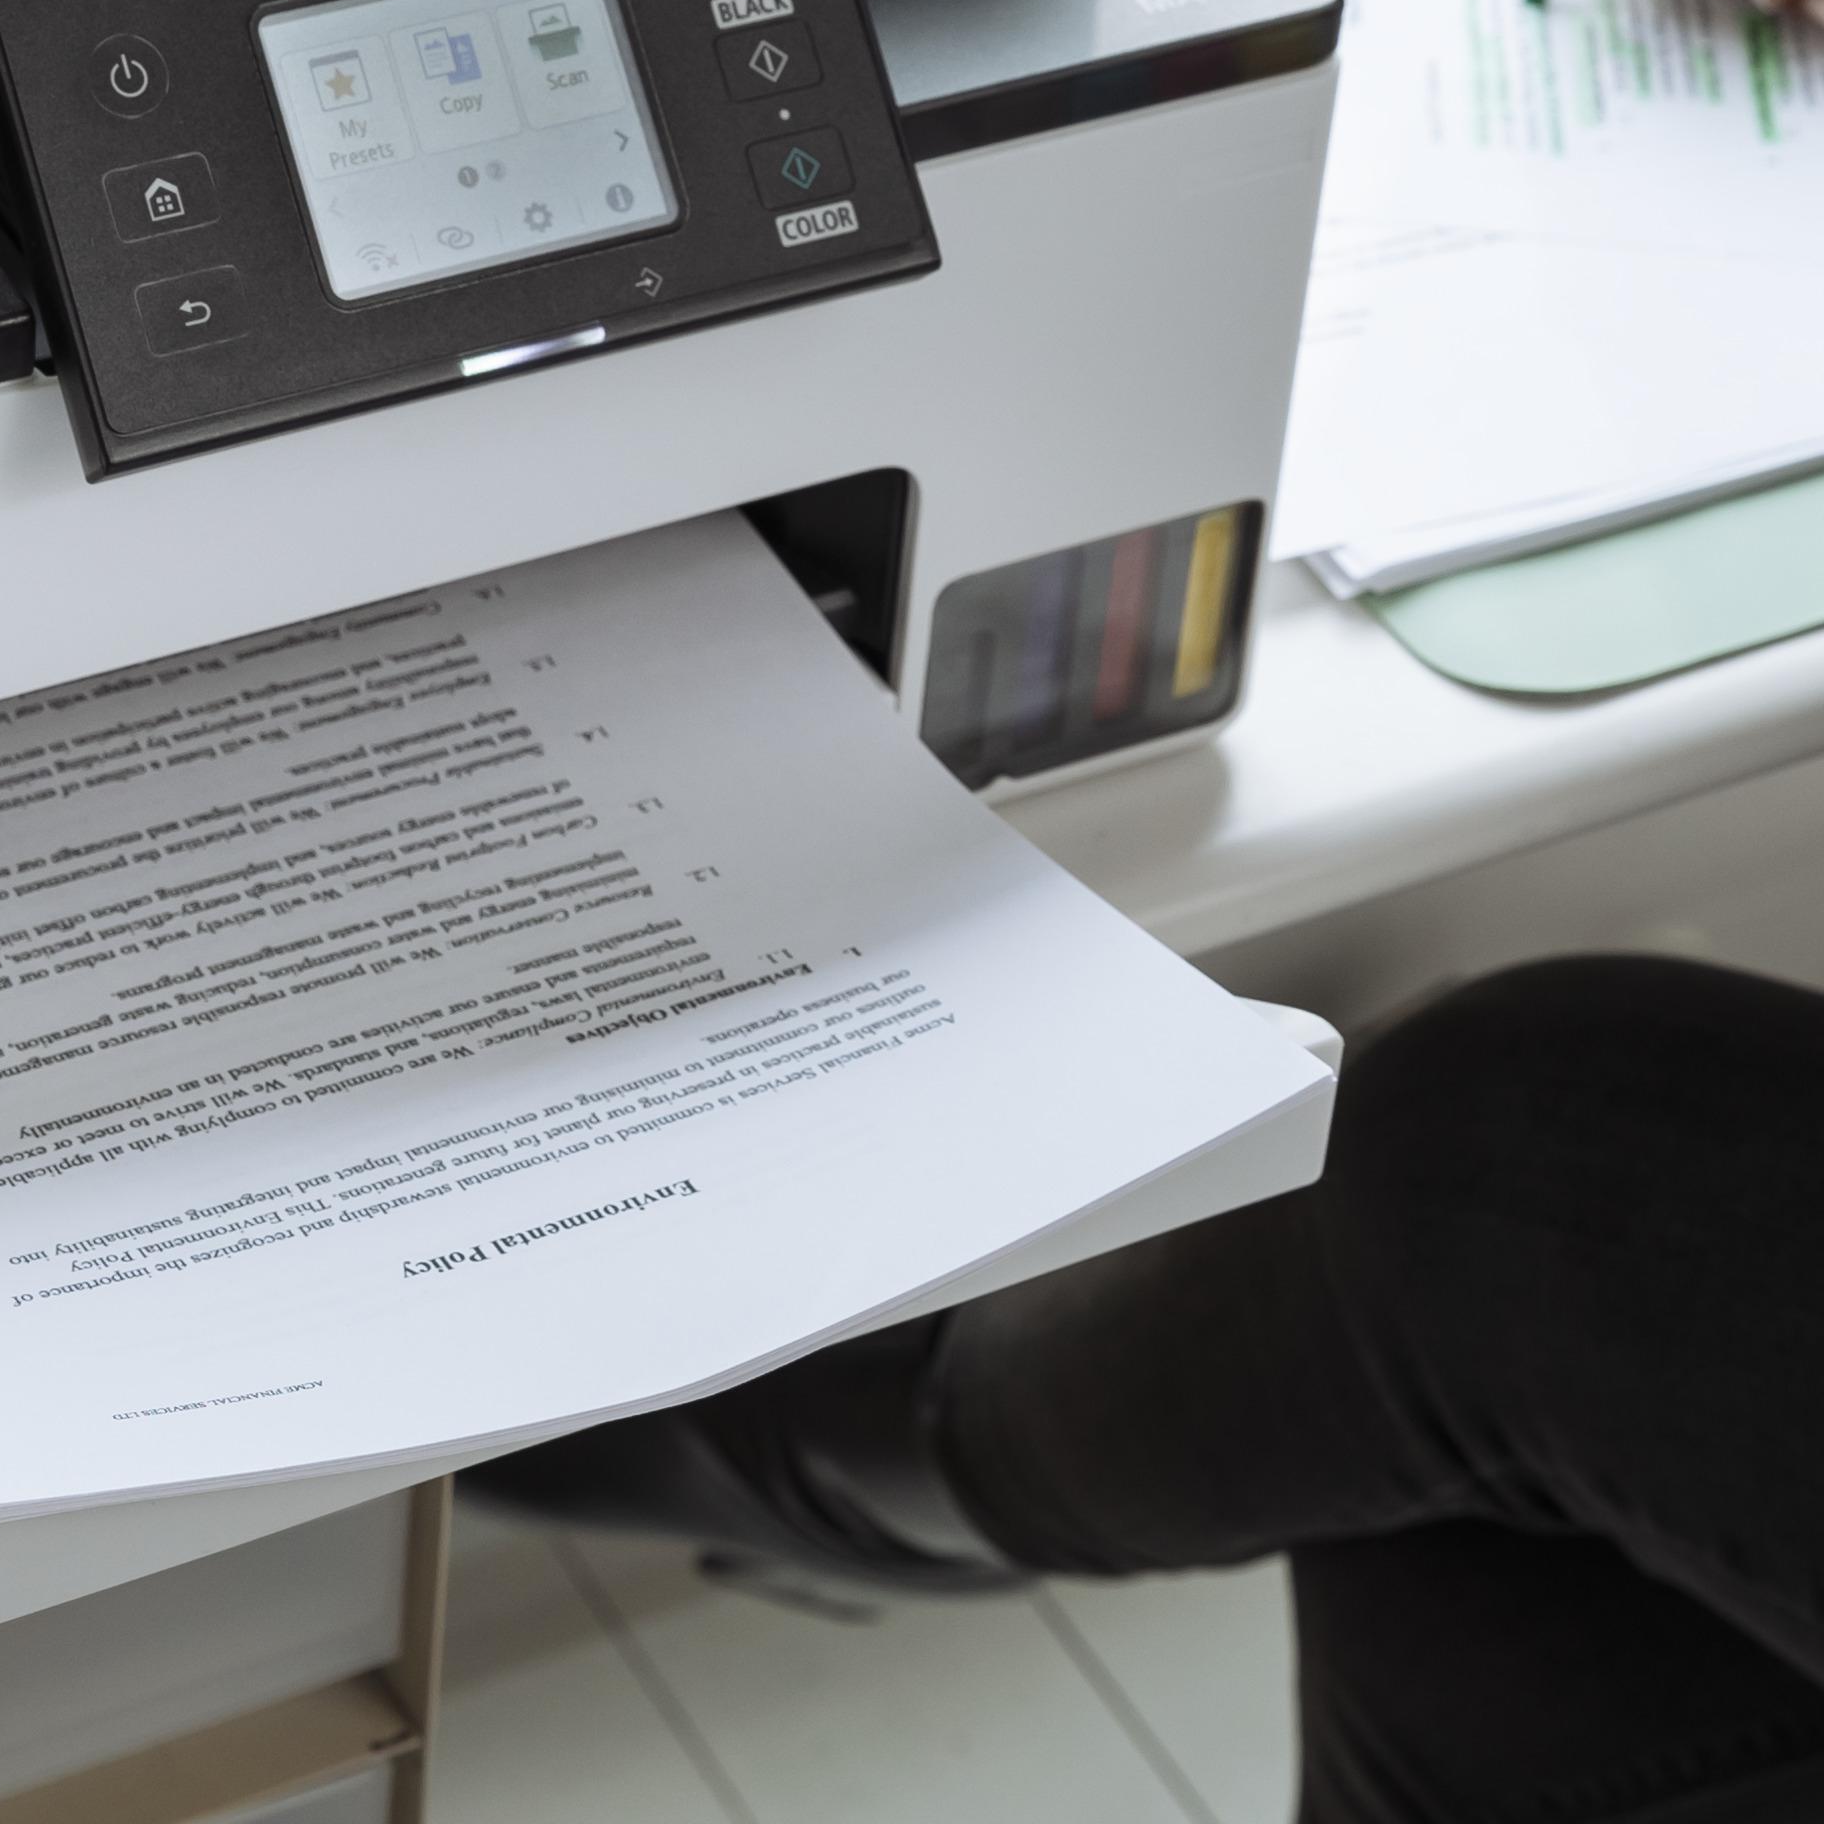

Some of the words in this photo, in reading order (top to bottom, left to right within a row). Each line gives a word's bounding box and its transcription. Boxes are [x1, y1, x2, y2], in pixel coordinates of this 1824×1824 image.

[546, 69, 590, 91] Scan
[439, 94, 483, 115] Copy
[338, 119, 367, 139] My
[329, 142, 395, 171] Presets
[780, 206, 855, 241] COLOR
[550, 778, 572, 796] of
[396, 809, 457, 835] energy
[461, 820, 496, 842] and
[530, 814, 599, 841] Carbon
[318, 827, 394, 855] sources,
[397, 830, 461, 856] carbon
[443, 832, 529, 867] Footprint
[282, 848, 318, 869] and
[316, 848, 399, 880] footprint
[503, 850, 626, 890] implementing
[154, 860, 281, 901] implementing
[243, 871, 318, 901] through
[343, 857, 442, 892] Reduction:
[685, 865, 721, 884] 1.2.
[88, 894, 154, 920] carbon
[269, 896, 308, 917] will
[309, 887, 344, 904] We
[415, 883, 504, 916] recycling
[477, 895, 538, 921] energy
[573, 883, 655, 915] Resource
[32, 913, 88, 938] offset
[97, 892, 241, 941] energy-efficient
[195, 906, 268, 936] actively
[381, 907, 417, 929] and
[438, 913, 474, 935] and
[444, 908, 570, 950] Conservation:
[142, 929, 192, 952] work
[326, 919, 381, 942] waste
[386, 924, 439, 947] water
[581, 917, 684, 955] responsible
[3, 929, 96, 965] practices,
[118, 942, 142, 956] to
[207, 935, 324, 976] management
[259, 940, 383, 980] consumption,
[408, 945, 443, 962] We
[581, 935, 697, 975] requirements
[757, 947, 795, 965] 1.1.
[842, 945, 863, 958] 1.
[53, 948, 118, 975] reduce
[368, 954, 408, 976] will
[504, 947, 581, 976] manner.
[17, 968, 51, 986] our
[110, 964, 206, 1002] programs.
[289, 962, 368, 996] promote
[542, 969, 580, 990] and
[583, 952, 711, 999] environmental
[880, 968, 912, 987] our
[172, 975, 259, 1007] reducing
[481, 979, 543, 1006] ensure
[530, 989, 584, 1010] laws,
[596, 968, 726, 1018] Environmental
[669, 963, 813, 1016] Environmental
[801, 981, 881, 1013] business
[854, 983, 927, 1016] outlines
[117, 1000, 173, 1023] waste
[180, 988, 288, 1027] responsible
[447, 998, 480, 1016] our
[822, 1010, 854, 1029] our
[844, 999, 942, 1041] sustainable
[7, 1013, 115, 1053] generation,
[97, 1019, 179, 1051] resource
[358, 1008, 445, 1041] activities
[420, 1004, 531, 1042] regulations,
[475, 1008, 593, 1049] Compliance:
[564, 1008, 669, 1045] Objectives
[699, 1008, 800, 1045] operations.
[902, 1012, 956, 1039] Acme
[327, 1033, 358, 1050] are
[383, 1037, 420, 1058] and
[440, 1044, 475, 1061] We
[706, 1023, 819, 1067] commitment
[759, 1033, 843, 1070] practices
[817, 1034, 904, 1075] Financial
[226, 1043, 325, 1082] conducted
[285, 1048, 383, 1082] standards.
[406, 1053, 438, 1070] are
[683, 1061, 706, 1074] to
[737, 1064, 760, 1078] in
[175, 1078, 202, 1094] an
[203, 1072, 226, 1086] in
[251, 1078, 287, 1094] We
[302, 1063, 405, 1103] committed
[574, 1067, 682, 1107] minimising
[637, 1069, 737, 1109] preserving
[736, 1066, 818, 1100] Services
[152, 1099, 208, 1123] strive
[209, 1087, 250, 1109] will
[280, 1093, 304, 1107] to
[542, 1101, 575, 1119] our
[716, 1094, 737, 1107] is
[19, 1088, 173, 1140] environmentally
[128, 1116, 151, 1129] to
[173, 1101, 278, 1138] complying
[542, 1111, 603, 1141] planet
[605, 1104, 637, 1121] our
[615, 1102, 715, 1142] committed
[52, 1138, 74, 1152] or
[75, 1122, 127, 1146] meet
[127, 1132, 173, 1153] with
[404, 1112, 538, 1162] environmental
[512, 1133, 542, 1150] for
[592, 1133, 616, 1146] to
[97, 1144, 125, 1163] all
[334, 1153, 403, 1181] impact
[450, 1143, 510, 1168] future
[456, 1141, 590, 1191] environmental
[294, 1173, 332, 1195] and
[331, 1159, 447, 1201] generations.
[184, 1184, 294, 1222] integrating
[283, 1198, 328, 1218] This
[338, 1183, 453, 1223] stewardship
[297, 1217, 336, 1239] and
[491, 1179, 698, 1255] Environmental
[55, 1216, 183, 1256] sustainability
[137, 1211, 283, 1259] Environmental
[189, 1228, 296, 1264] recognizes
[7, 1249, 49, 1266] into
[70, 1249, 135, 1274] Policy
[153, 1257, 188, 1273] the
[402, 1244, 489, 1279] Policy
[37, 1266, 151, 1299] importance
[11, 1292, 35, 1308] of
[207, 1387, 284, 1407] FINANCIAL
[284, 1379, 324, 1394] ACME
[111, 1410, 141, 1421] LTD
[140, 1400, 208, 1417] SERVICES
